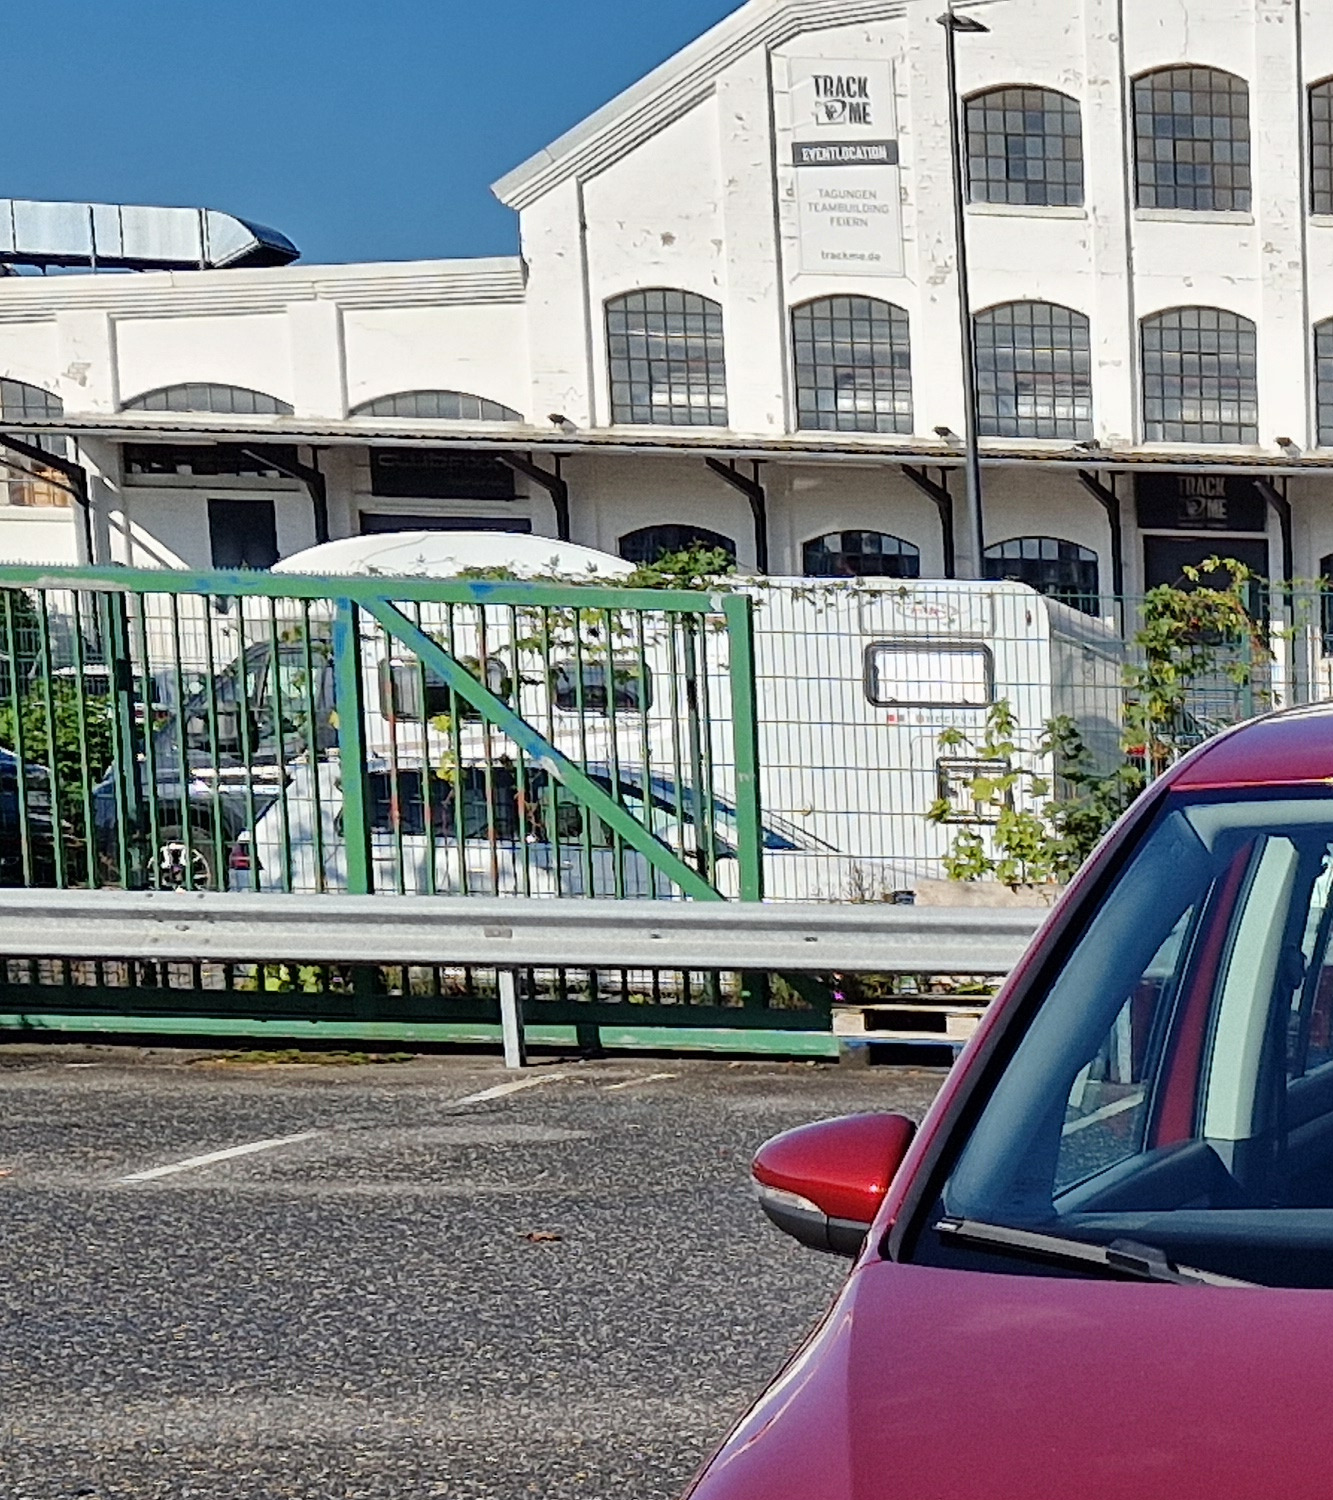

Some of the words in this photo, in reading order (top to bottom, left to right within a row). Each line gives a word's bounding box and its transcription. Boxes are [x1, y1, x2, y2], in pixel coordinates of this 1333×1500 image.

[811, 75, 869, 98] TRACK
[849, 102, 872, 125] ME
[801, 145, 888, 161] EVENTLOCATION
[818, 188, 877, 200] TAGUNGEN
[807, 202, 889, 214] TEAMBUILDING
[829, 216, 869, 227] FEIERN
[1177, 476, 1226, 496] TRACK
[1207, 499, 1227, 519] ME
